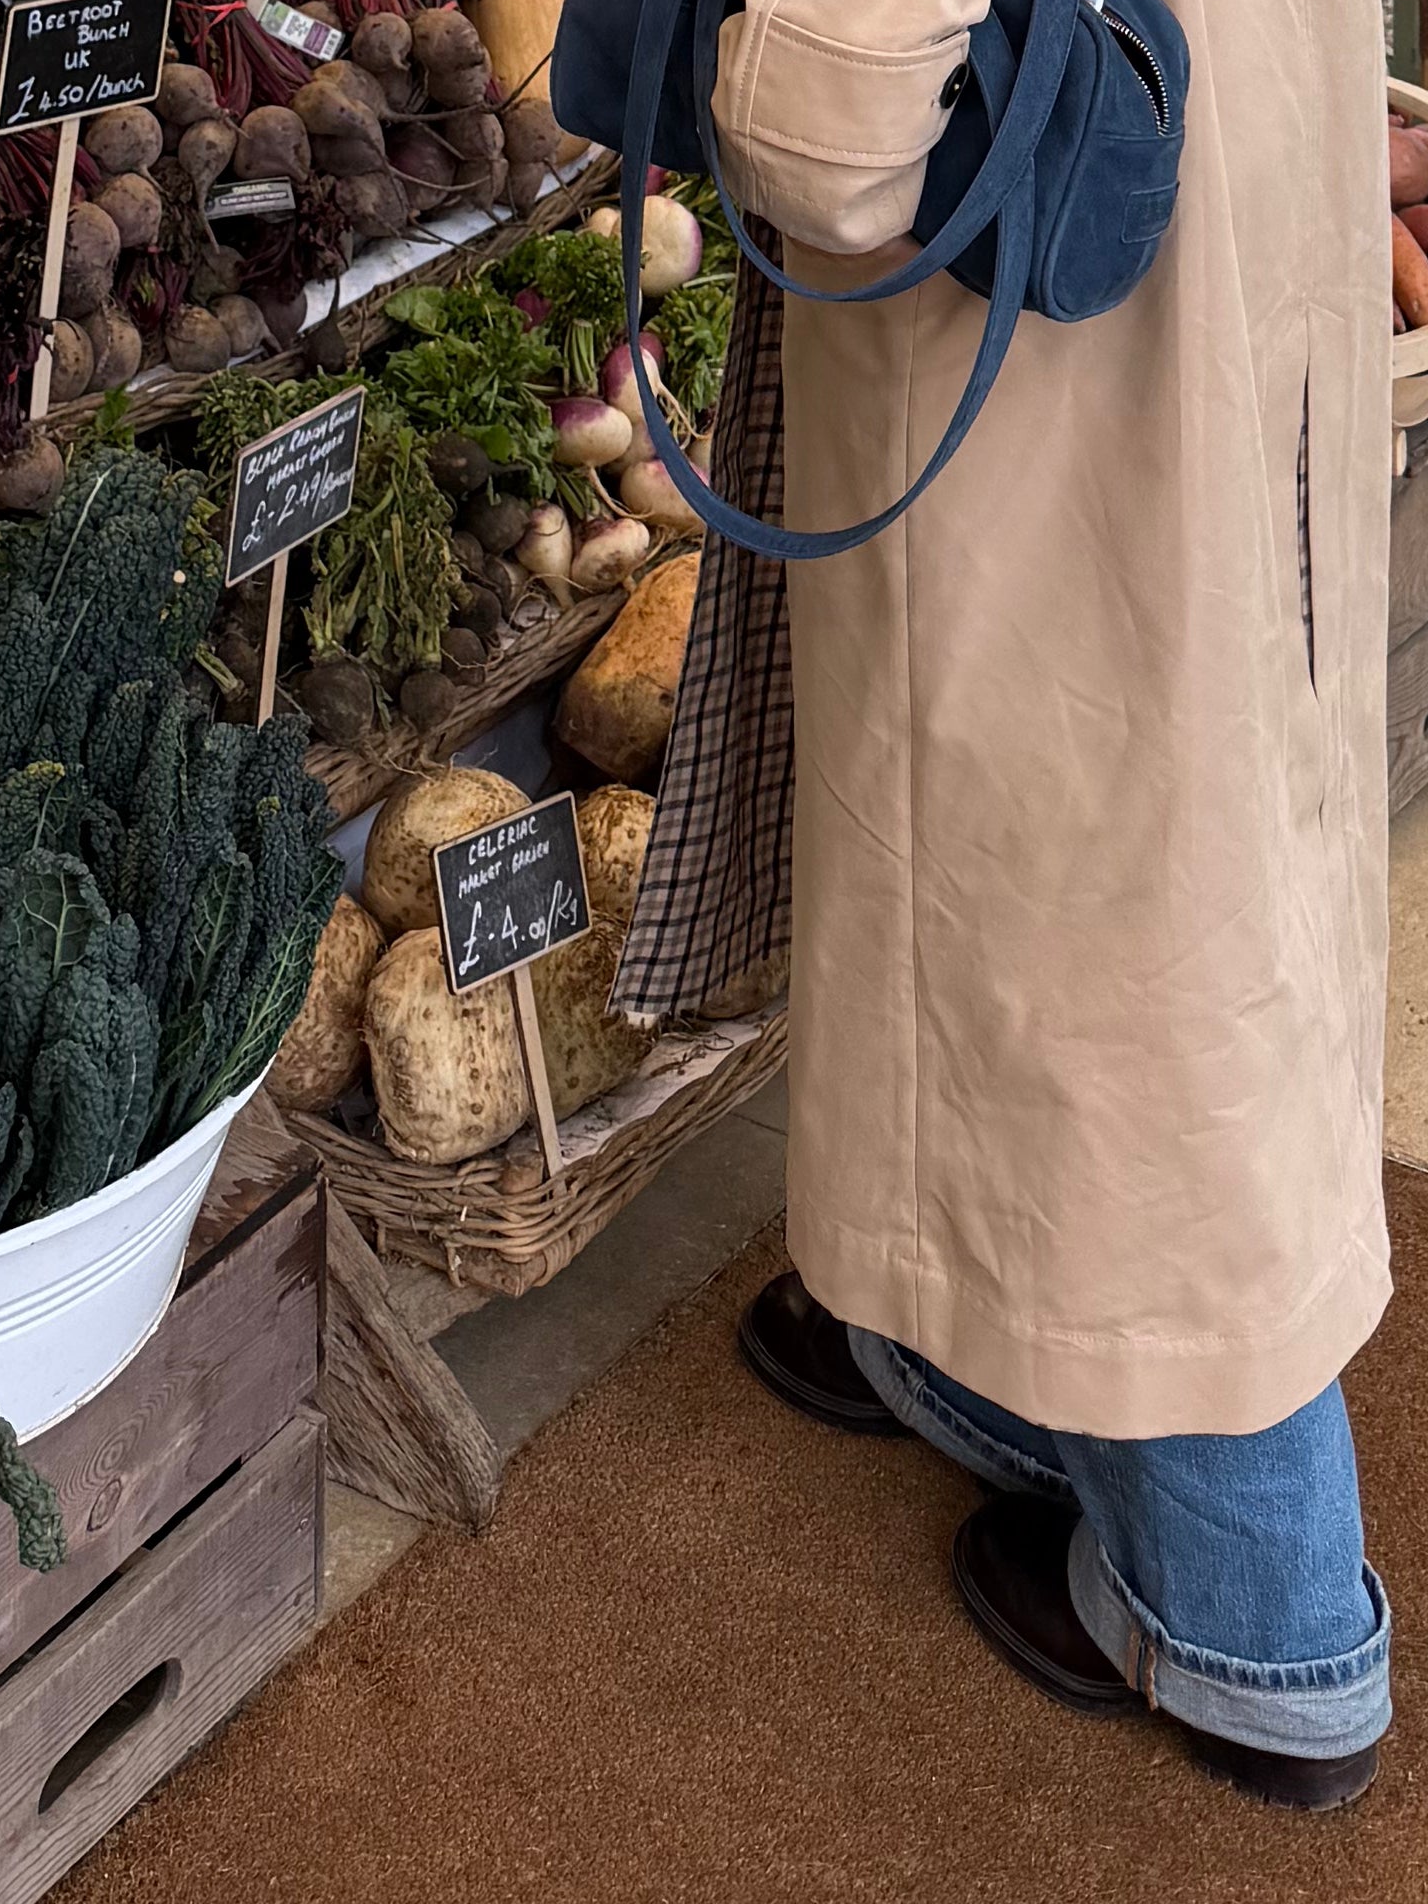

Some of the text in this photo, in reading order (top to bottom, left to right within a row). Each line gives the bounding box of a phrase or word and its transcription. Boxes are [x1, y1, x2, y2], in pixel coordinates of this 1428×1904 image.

[27, 0, 124, 41] BEETROOT
[63, 49, 91, 71] UK
[468, 814, 540, 866] CELERIAC
